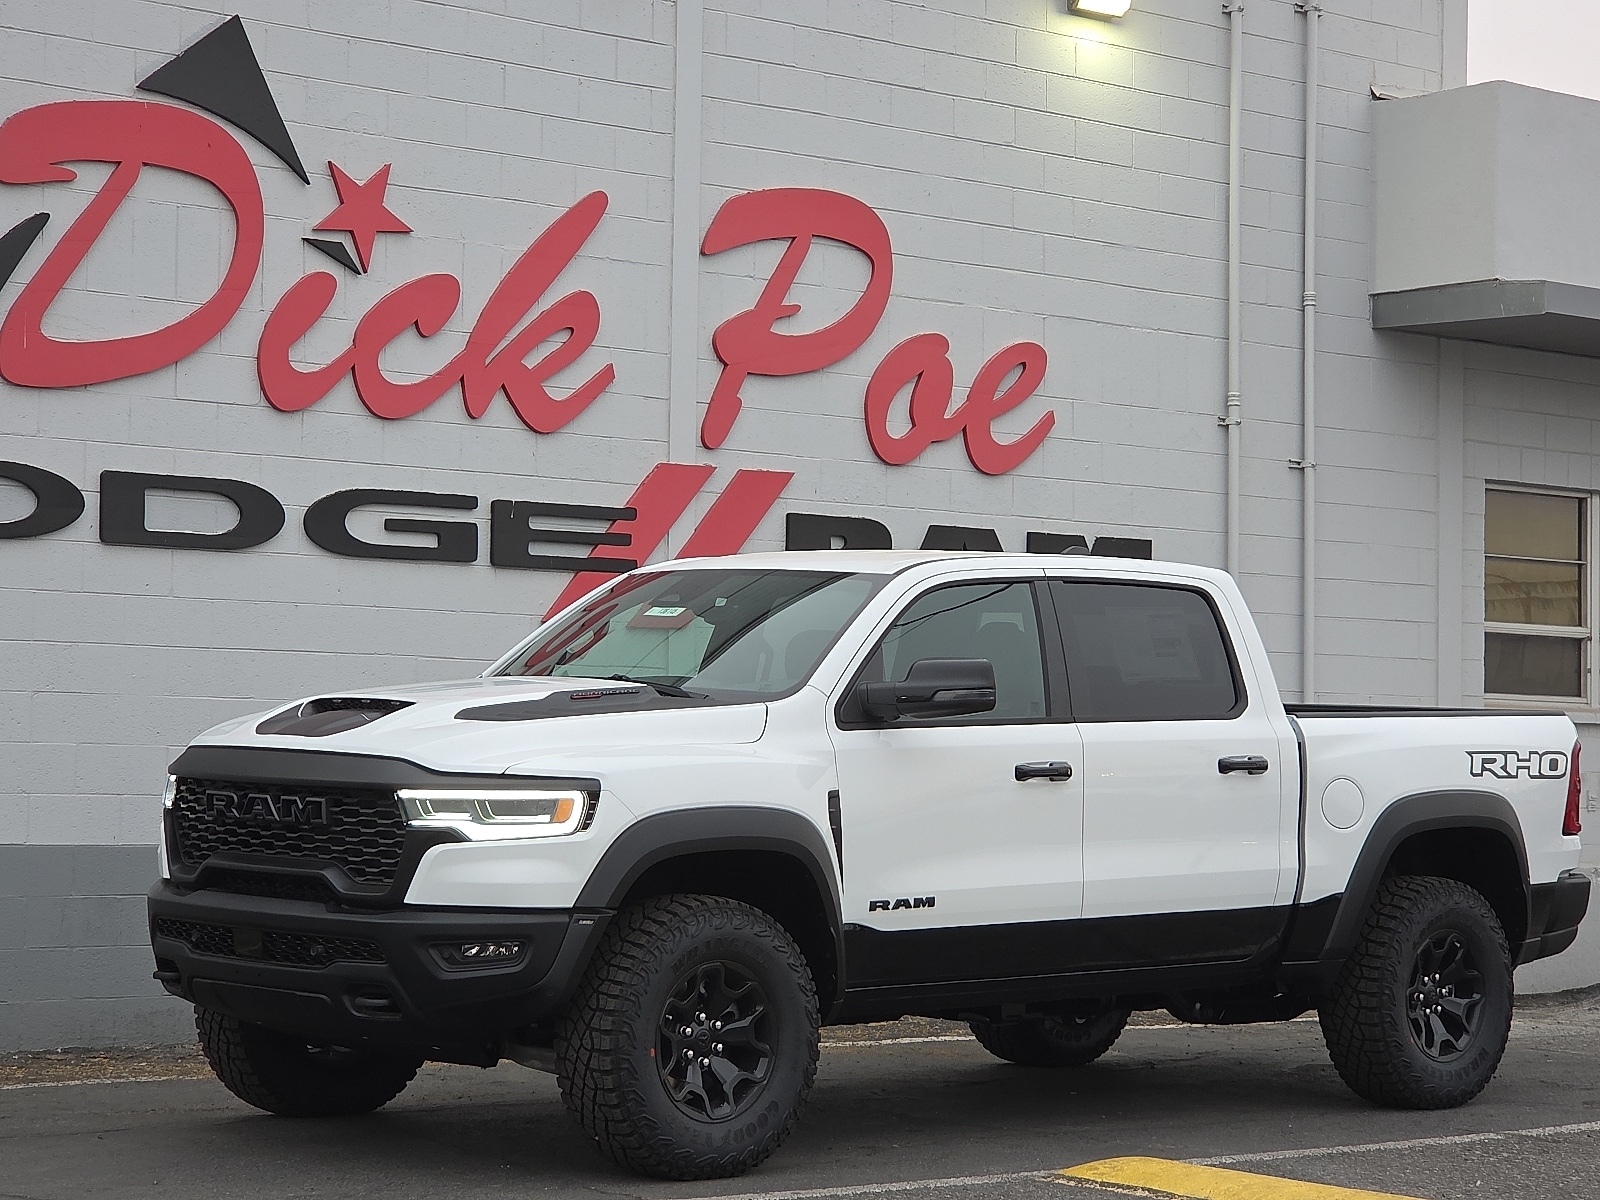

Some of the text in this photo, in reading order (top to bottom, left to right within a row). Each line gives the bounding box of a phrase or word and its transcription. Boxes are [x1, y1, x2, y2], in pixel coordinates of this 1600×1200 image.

[0, 100, 1055, 476] Dick Poe
[1464, 751, 1568, 779] RHO
[205, 789, 327, 825] RAM
[869, 896, 936, 912] RAM
